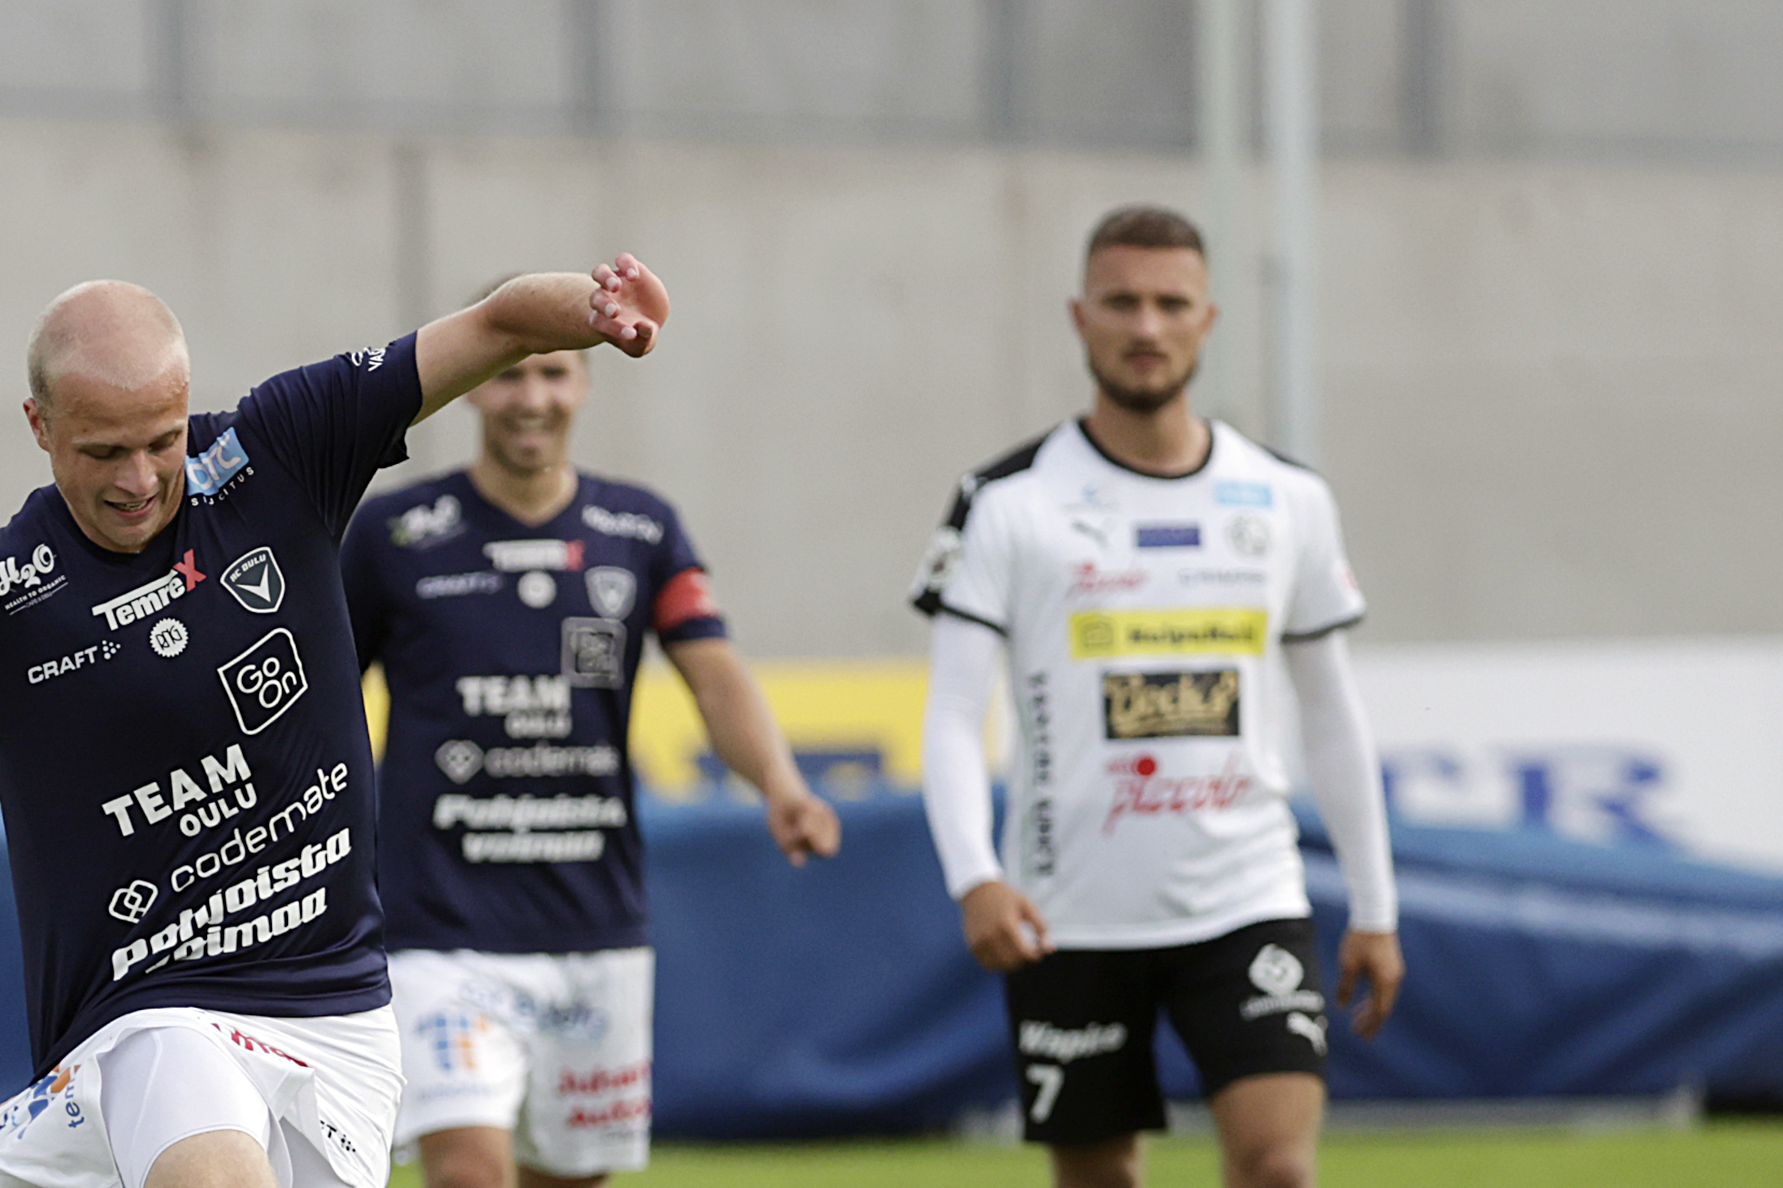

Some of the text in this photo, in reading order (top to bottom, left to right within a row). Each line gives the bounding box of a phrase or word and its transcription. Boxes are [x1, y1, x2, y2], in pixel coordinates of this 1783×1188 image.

[4, 594, 28, 611] HEALTH
[27, 590, 38, 600] TO
[27, 645, 99, 685] CRAFT
[236, 656, 281, 694] Go
[258, 671, 298, 709] On
[101, 743, 252, 837] TEAM
[179, 782, 258, 837] OULU
[171, 762, 348, 892] codemate
[1026, 1063, 1064, 1124] 7
